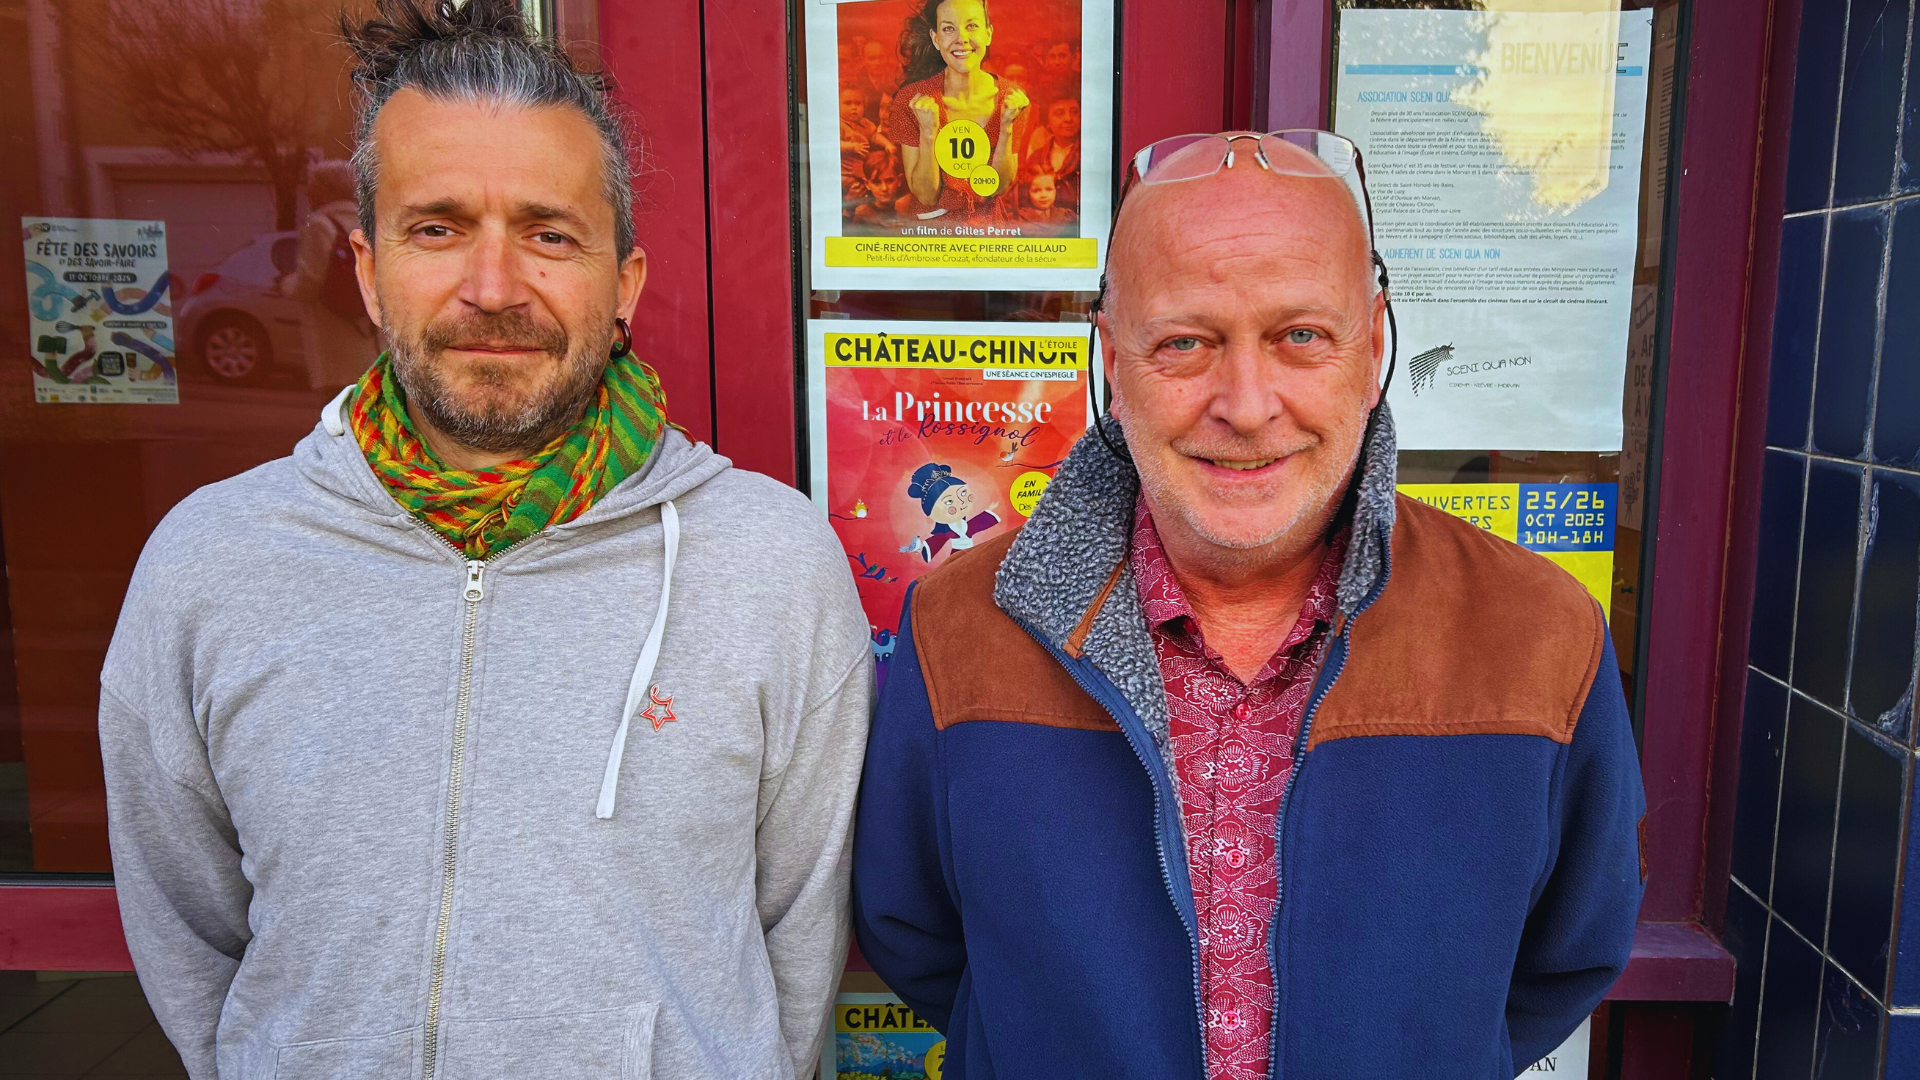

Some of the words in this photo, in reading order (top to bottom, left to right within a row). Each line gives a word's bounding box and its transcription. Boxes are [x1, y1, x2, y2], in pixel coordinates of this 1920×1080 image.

[1501, 42, 1628, 74] BIENVENUE
[1357, 92, 1407, 102] ASSOCIATION
[1411, 92, 1432, 102] SCENI
[949, 138, 975, 160] 10
[901, 228, 914, 236] un
[917, 226, 938, 236] film
[940, 226, 952, 236] de
[955, 226, 985, 236] Gilles
[988, 226, 1022, 236] Perret
[37, 238, 68, 256] FÊTE
[74, 243, 98, 256] DES
[104, 244, 157, 258] SAVOIRS
[855, 242, 947, 252] CINÉ-RENCONTRE
[949, 244, 977, 252] AVEC
[979, 244, 1014, 252] PIERRE
[1016, 244, 1067, 253] CAILLAUD
[866, 254, 896, 262] Petit-fils
[897, 254, 940, 262] d'Ambroise
[972, 254, 1013, 263] «fondateur
[1384, 248, 1425, 259] ADHERENT
[1426, 248, 1436, 258] DE
[1440, 248, 1462, 259] SCENI
[1464, 248, 1480, 259] QUA
[1484, 248, 1500, 259] NON
[68, 258, 82, 267] DES
[85, 258, 136, 268] SAVOIR-FAIRE
[1040, 340, 1078, 348] L'ÉTOILE
[1447, 363, 1479, 376] SCENI
[1482, 359, 1506, 371] QUA
[1509, 356, 1532, 368] NON
[1002, 370, 1028, 379] SÉANCE
[1030, 371, 1074, 379] CIN'ESPIEGLE
[863, 400, 887, 421] La
[895, 391, 1052, 424] Princesse
[879, 430, 897, 446] et
[898, 427, 912, 442] le
[917, 412, 1040, 446] Rossignol
[1024, 480, 1036, 488] EN
[1017, 489, 1042, 499] FAMIL
[1526, 491, 1605, 510] 25/26
[1018, 502, 1032, 511] Dès
[1525, 514, 1555, 527] OCT
[1565, 514, 1605, 526] 2025
[1524, 530, 1603, 544] 10H-18H
[845, 1002, 932, 1028] CHÂTE
